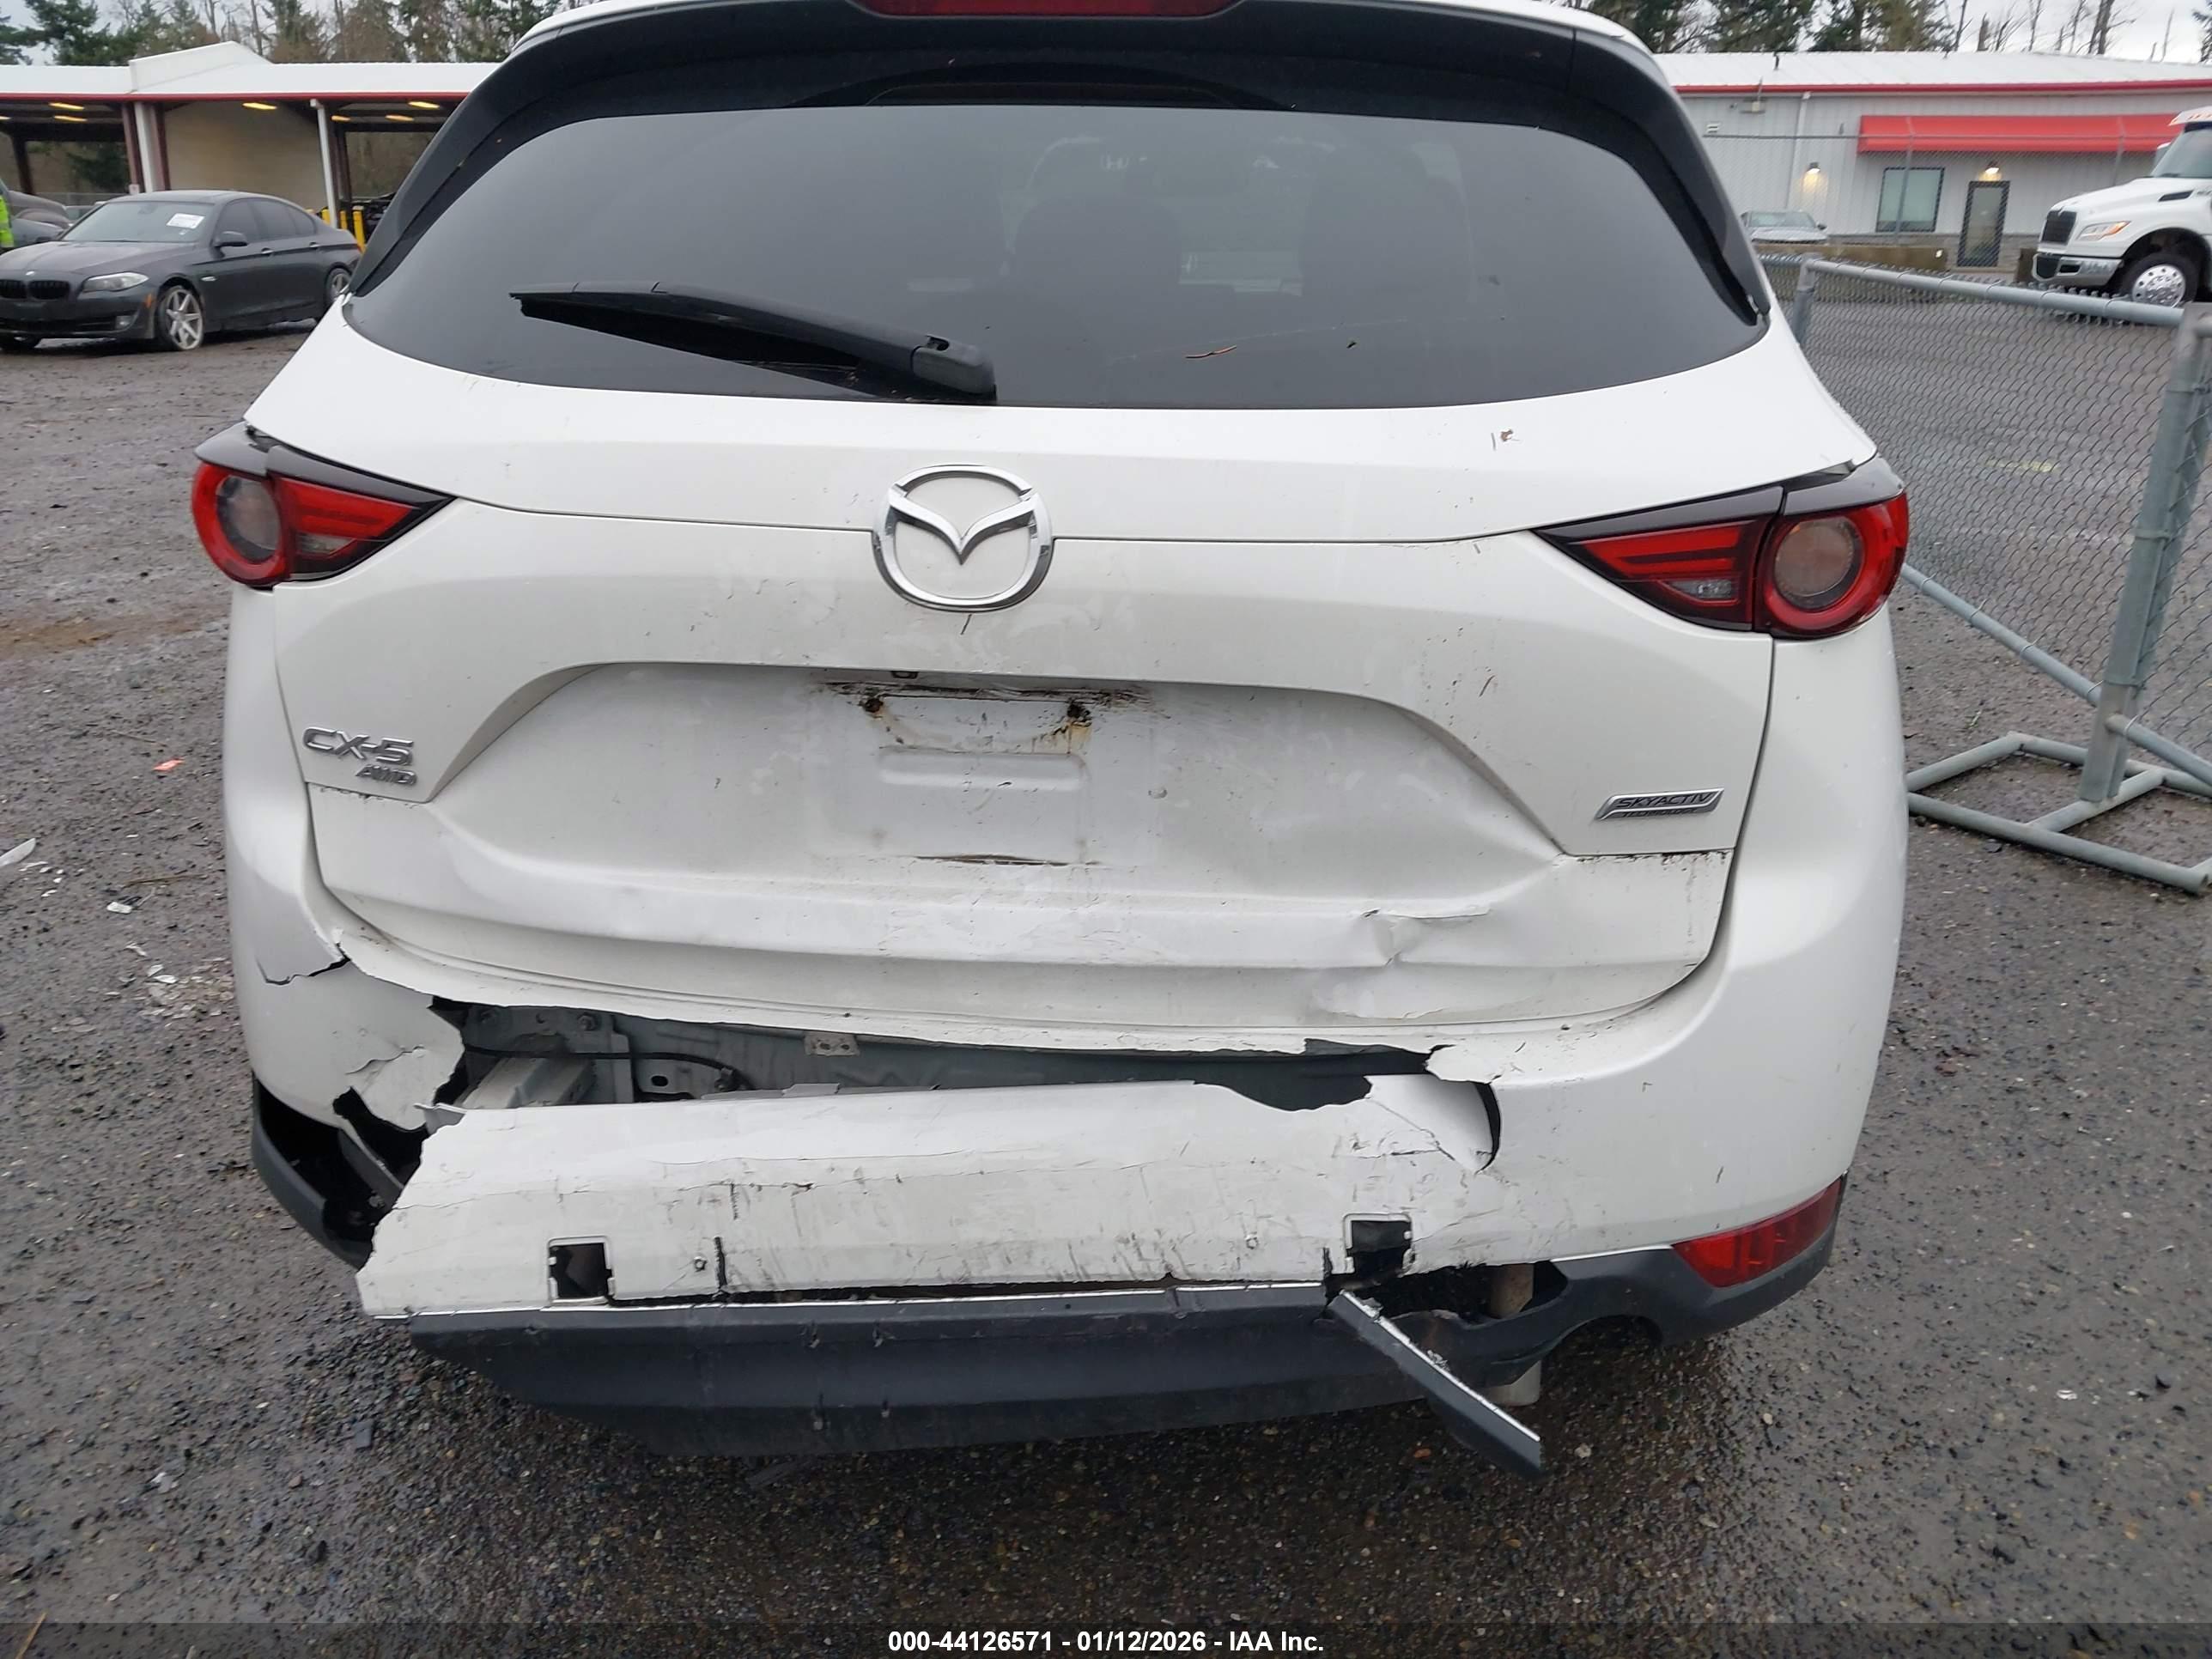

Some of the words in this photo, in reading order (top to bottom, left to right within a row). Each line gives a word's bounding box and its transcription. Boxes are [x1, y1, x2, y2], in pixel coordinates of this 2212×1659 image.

[303, 726, 414, 765] CX-5
[356, 764, 418, 785] AWD
[1615, 793, 1716, 809] SKYACTIV
